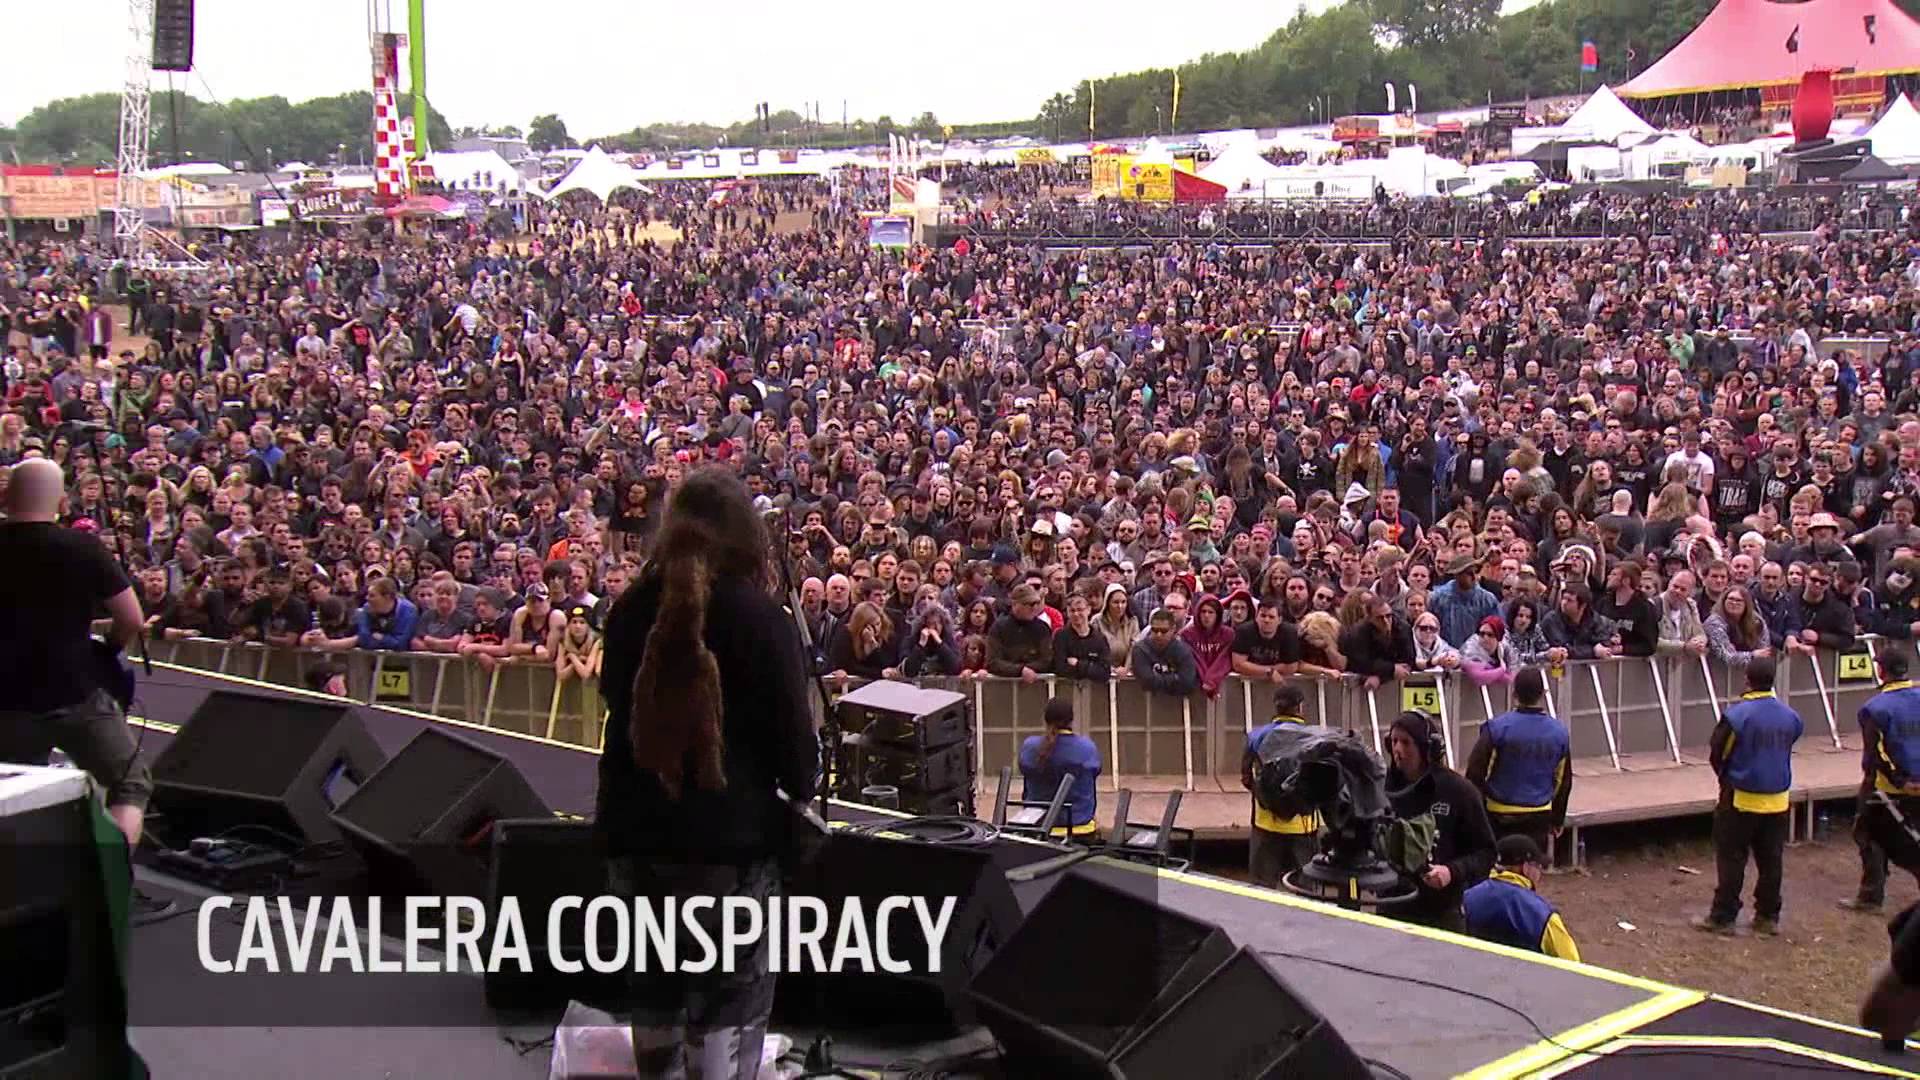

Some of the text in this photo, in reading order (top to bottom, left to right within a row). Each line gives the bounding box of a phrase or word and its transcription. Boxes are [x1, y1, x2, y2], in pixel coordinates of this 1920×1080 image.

[1849, 657, 1867, 670] L4
[382, 674, 401, 688] L7
[1413, 692, 1434, 706] L5
